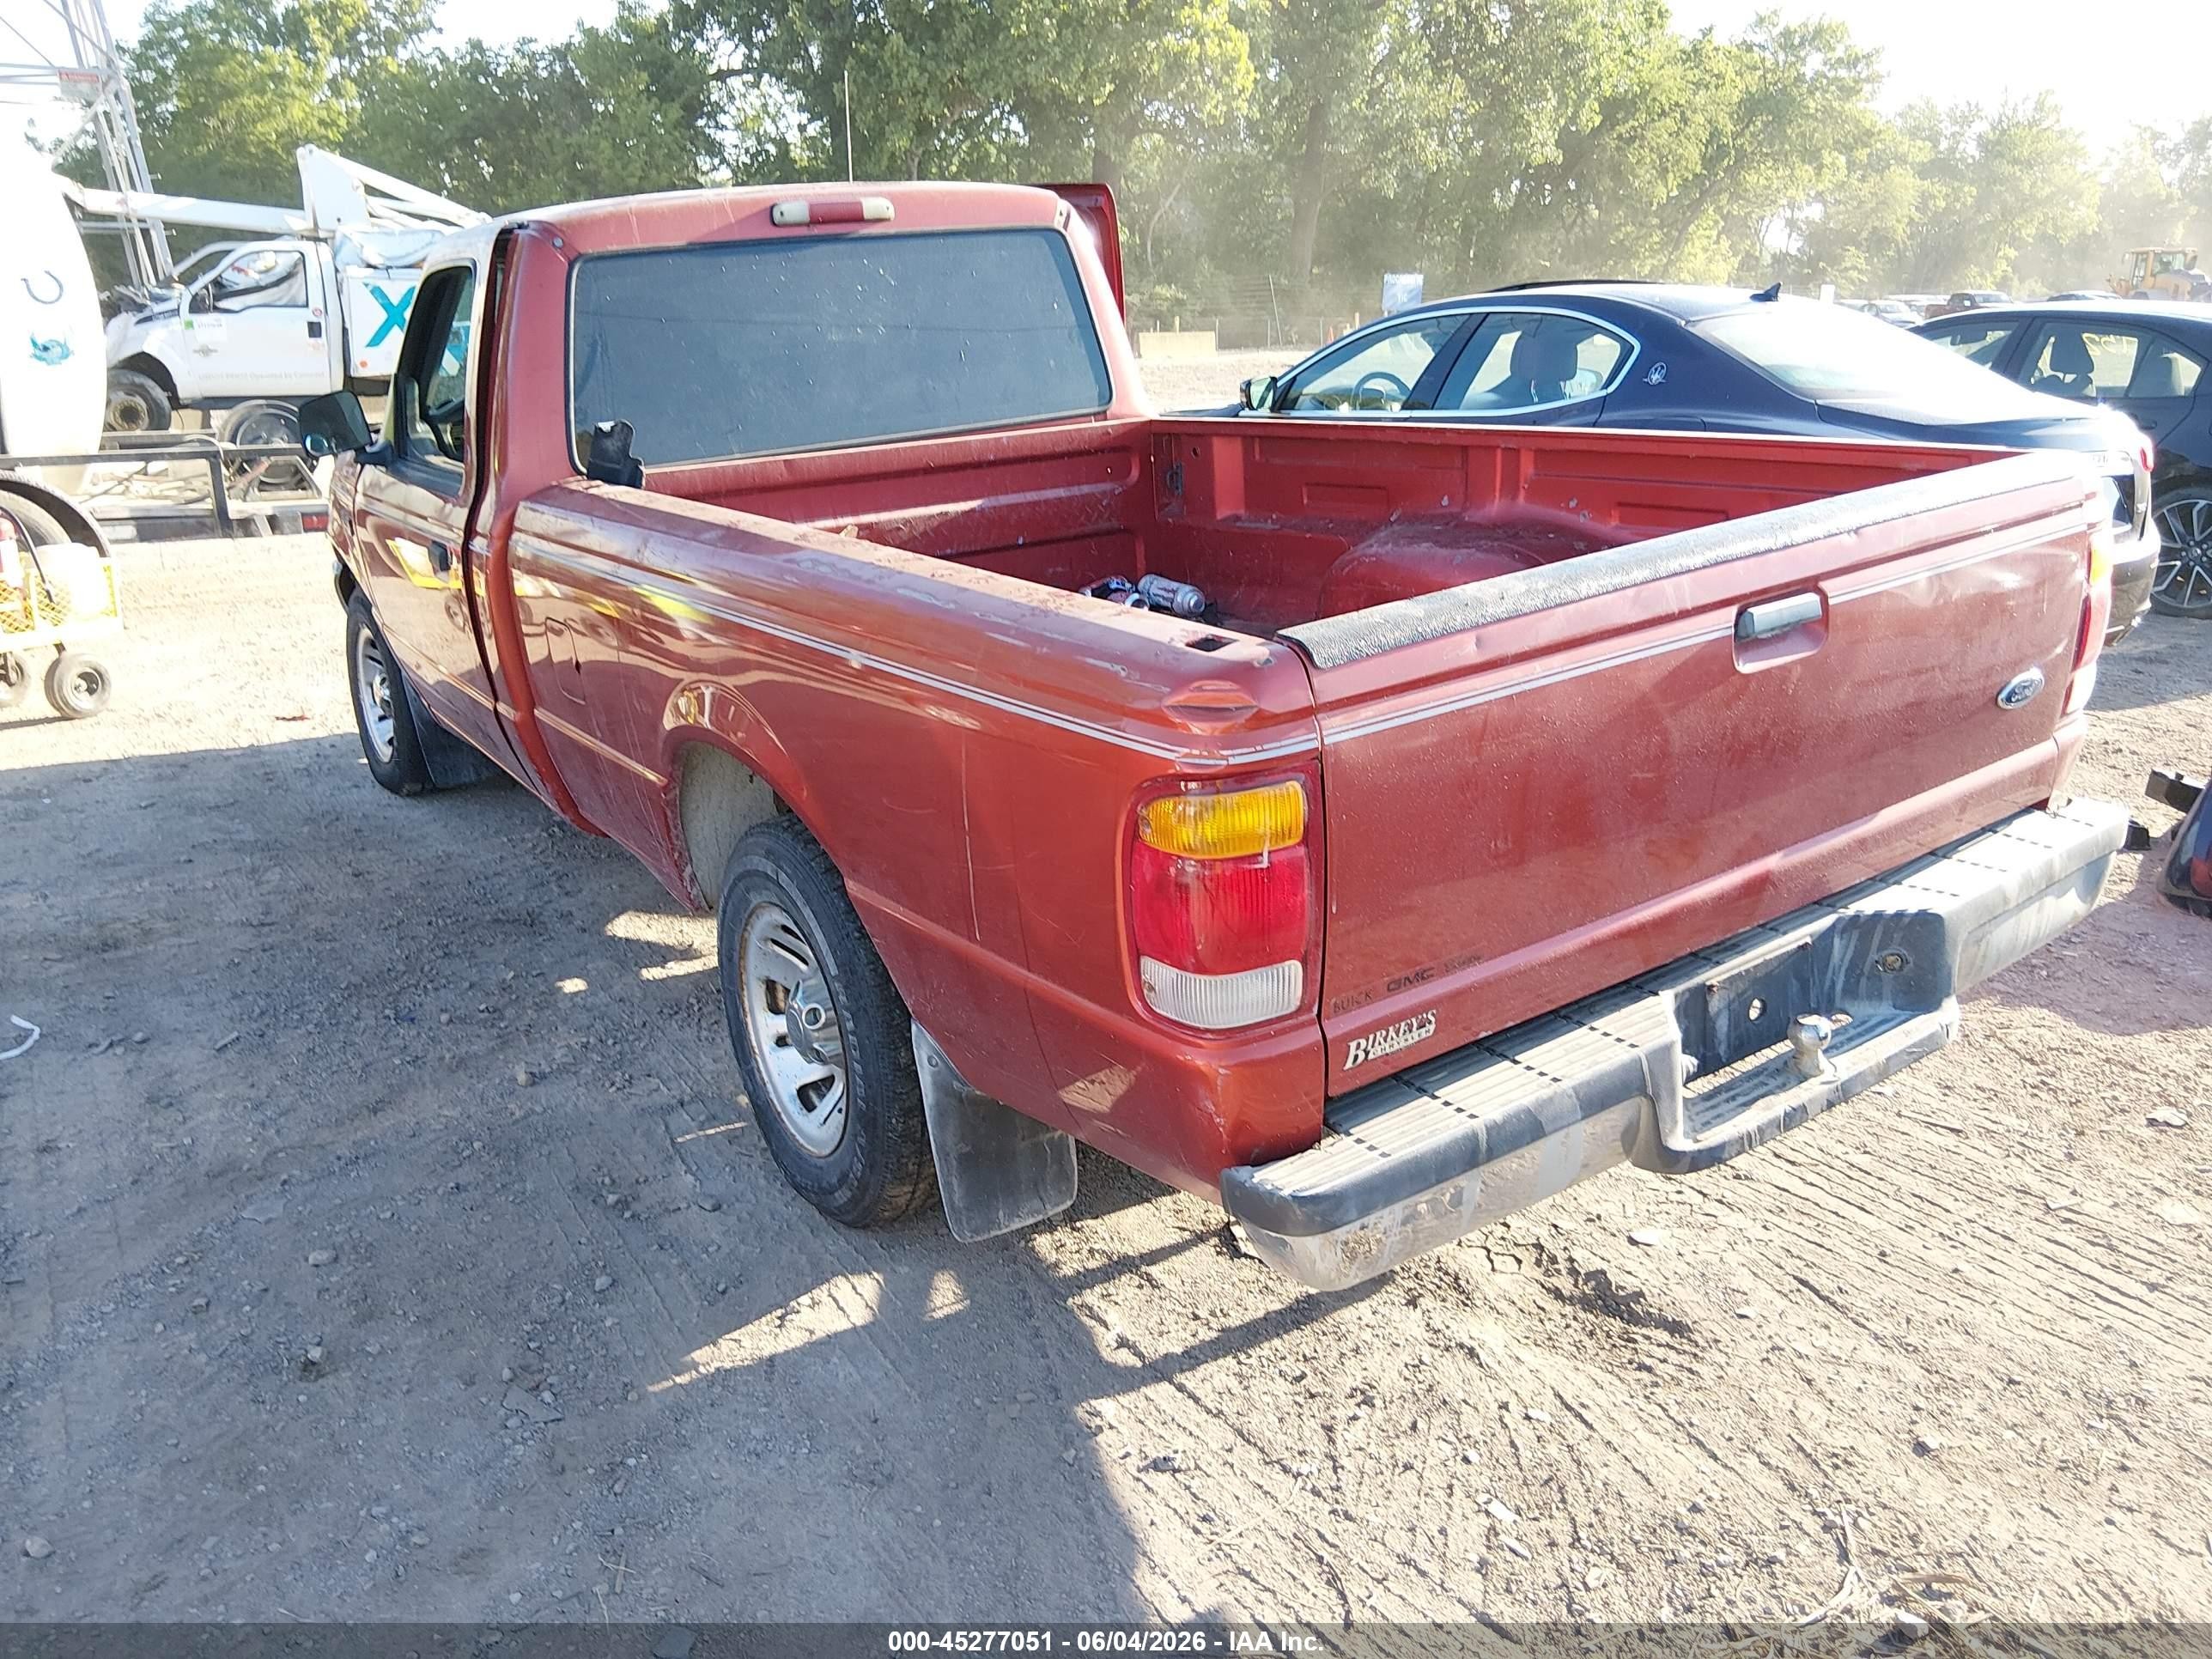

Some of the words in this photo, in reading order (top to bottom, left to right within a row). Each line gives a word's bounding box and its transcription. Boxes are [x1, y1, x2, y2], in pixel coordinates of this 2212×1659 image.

[1333, 988, 1374, 1013] BUICK
[1386, 967, 1437, 993] GMC
[1343, 1009, 1437, 1071] BIRKEY'S
